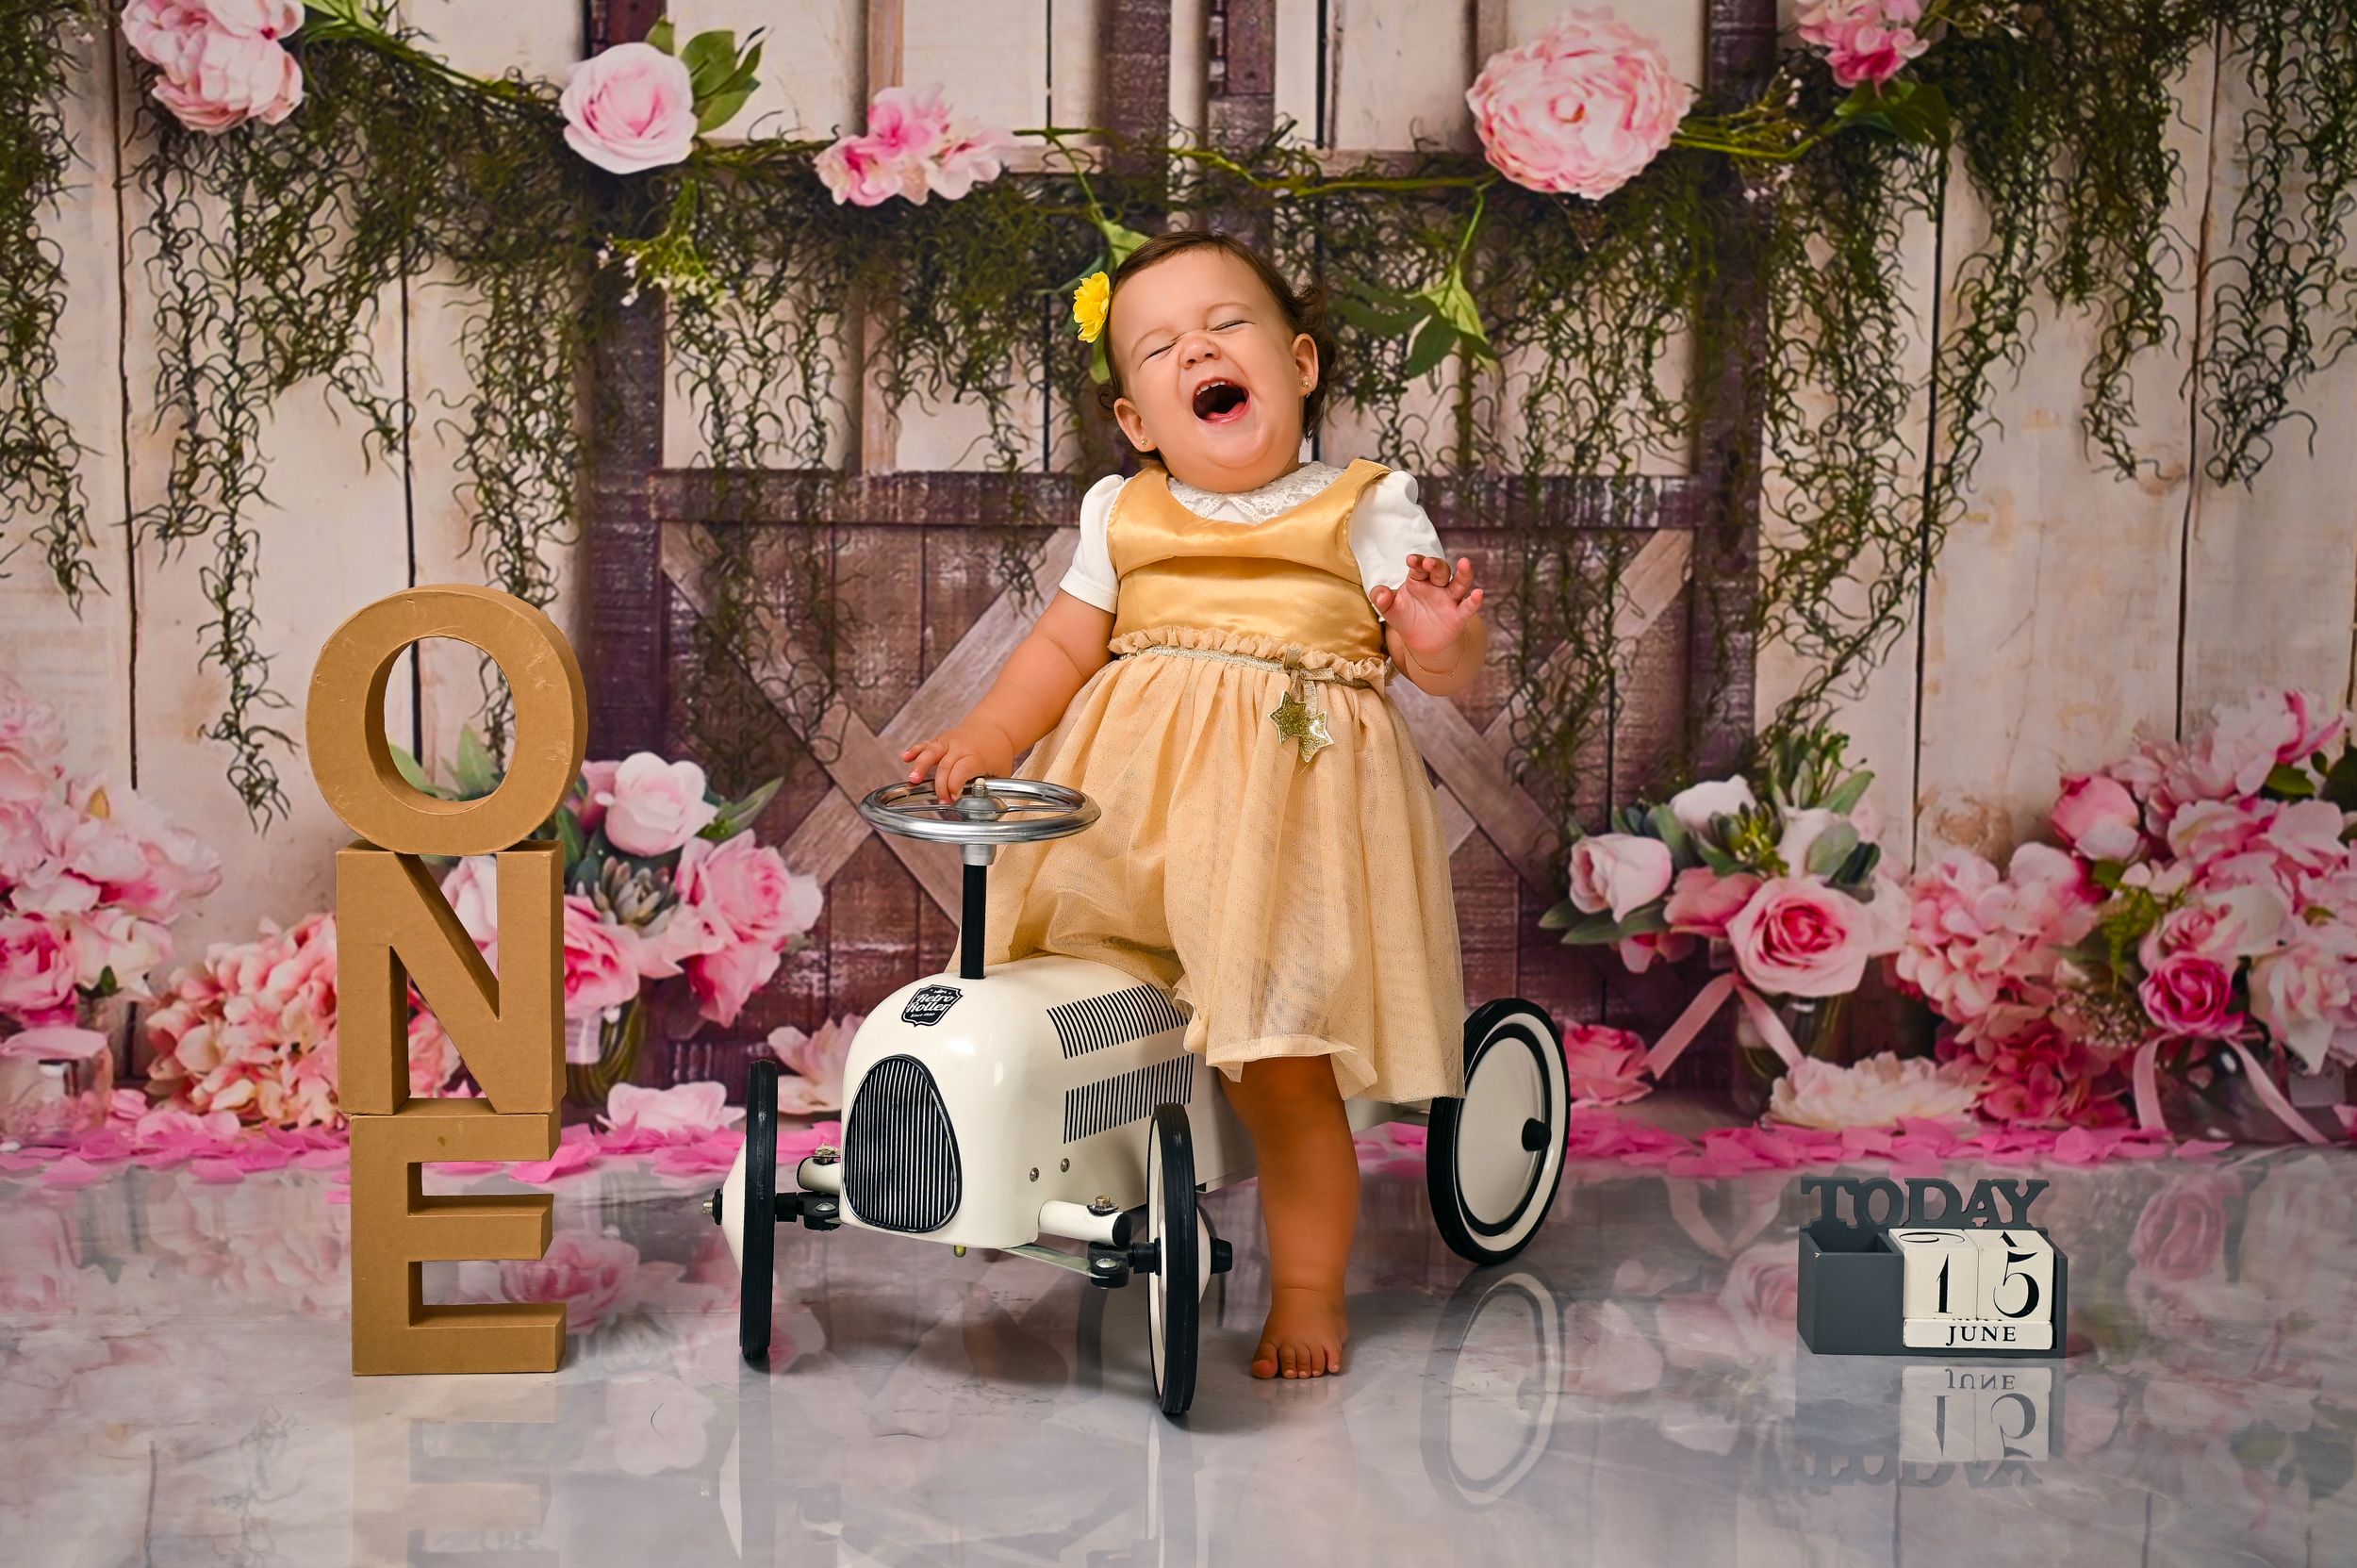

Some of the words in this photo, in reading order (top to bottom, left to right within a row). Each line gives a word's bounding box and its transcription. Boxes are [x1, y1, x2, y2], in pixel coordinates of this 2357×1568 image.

[305, 584, 587, 1376] ONE
[906, 1001, 951, 1014] Roller
[916, 993, 955, 1003] Retro
[1801, 1178, 2050, 1229] TODAY
[1945, 1325, 2017, 1346] JUNE
